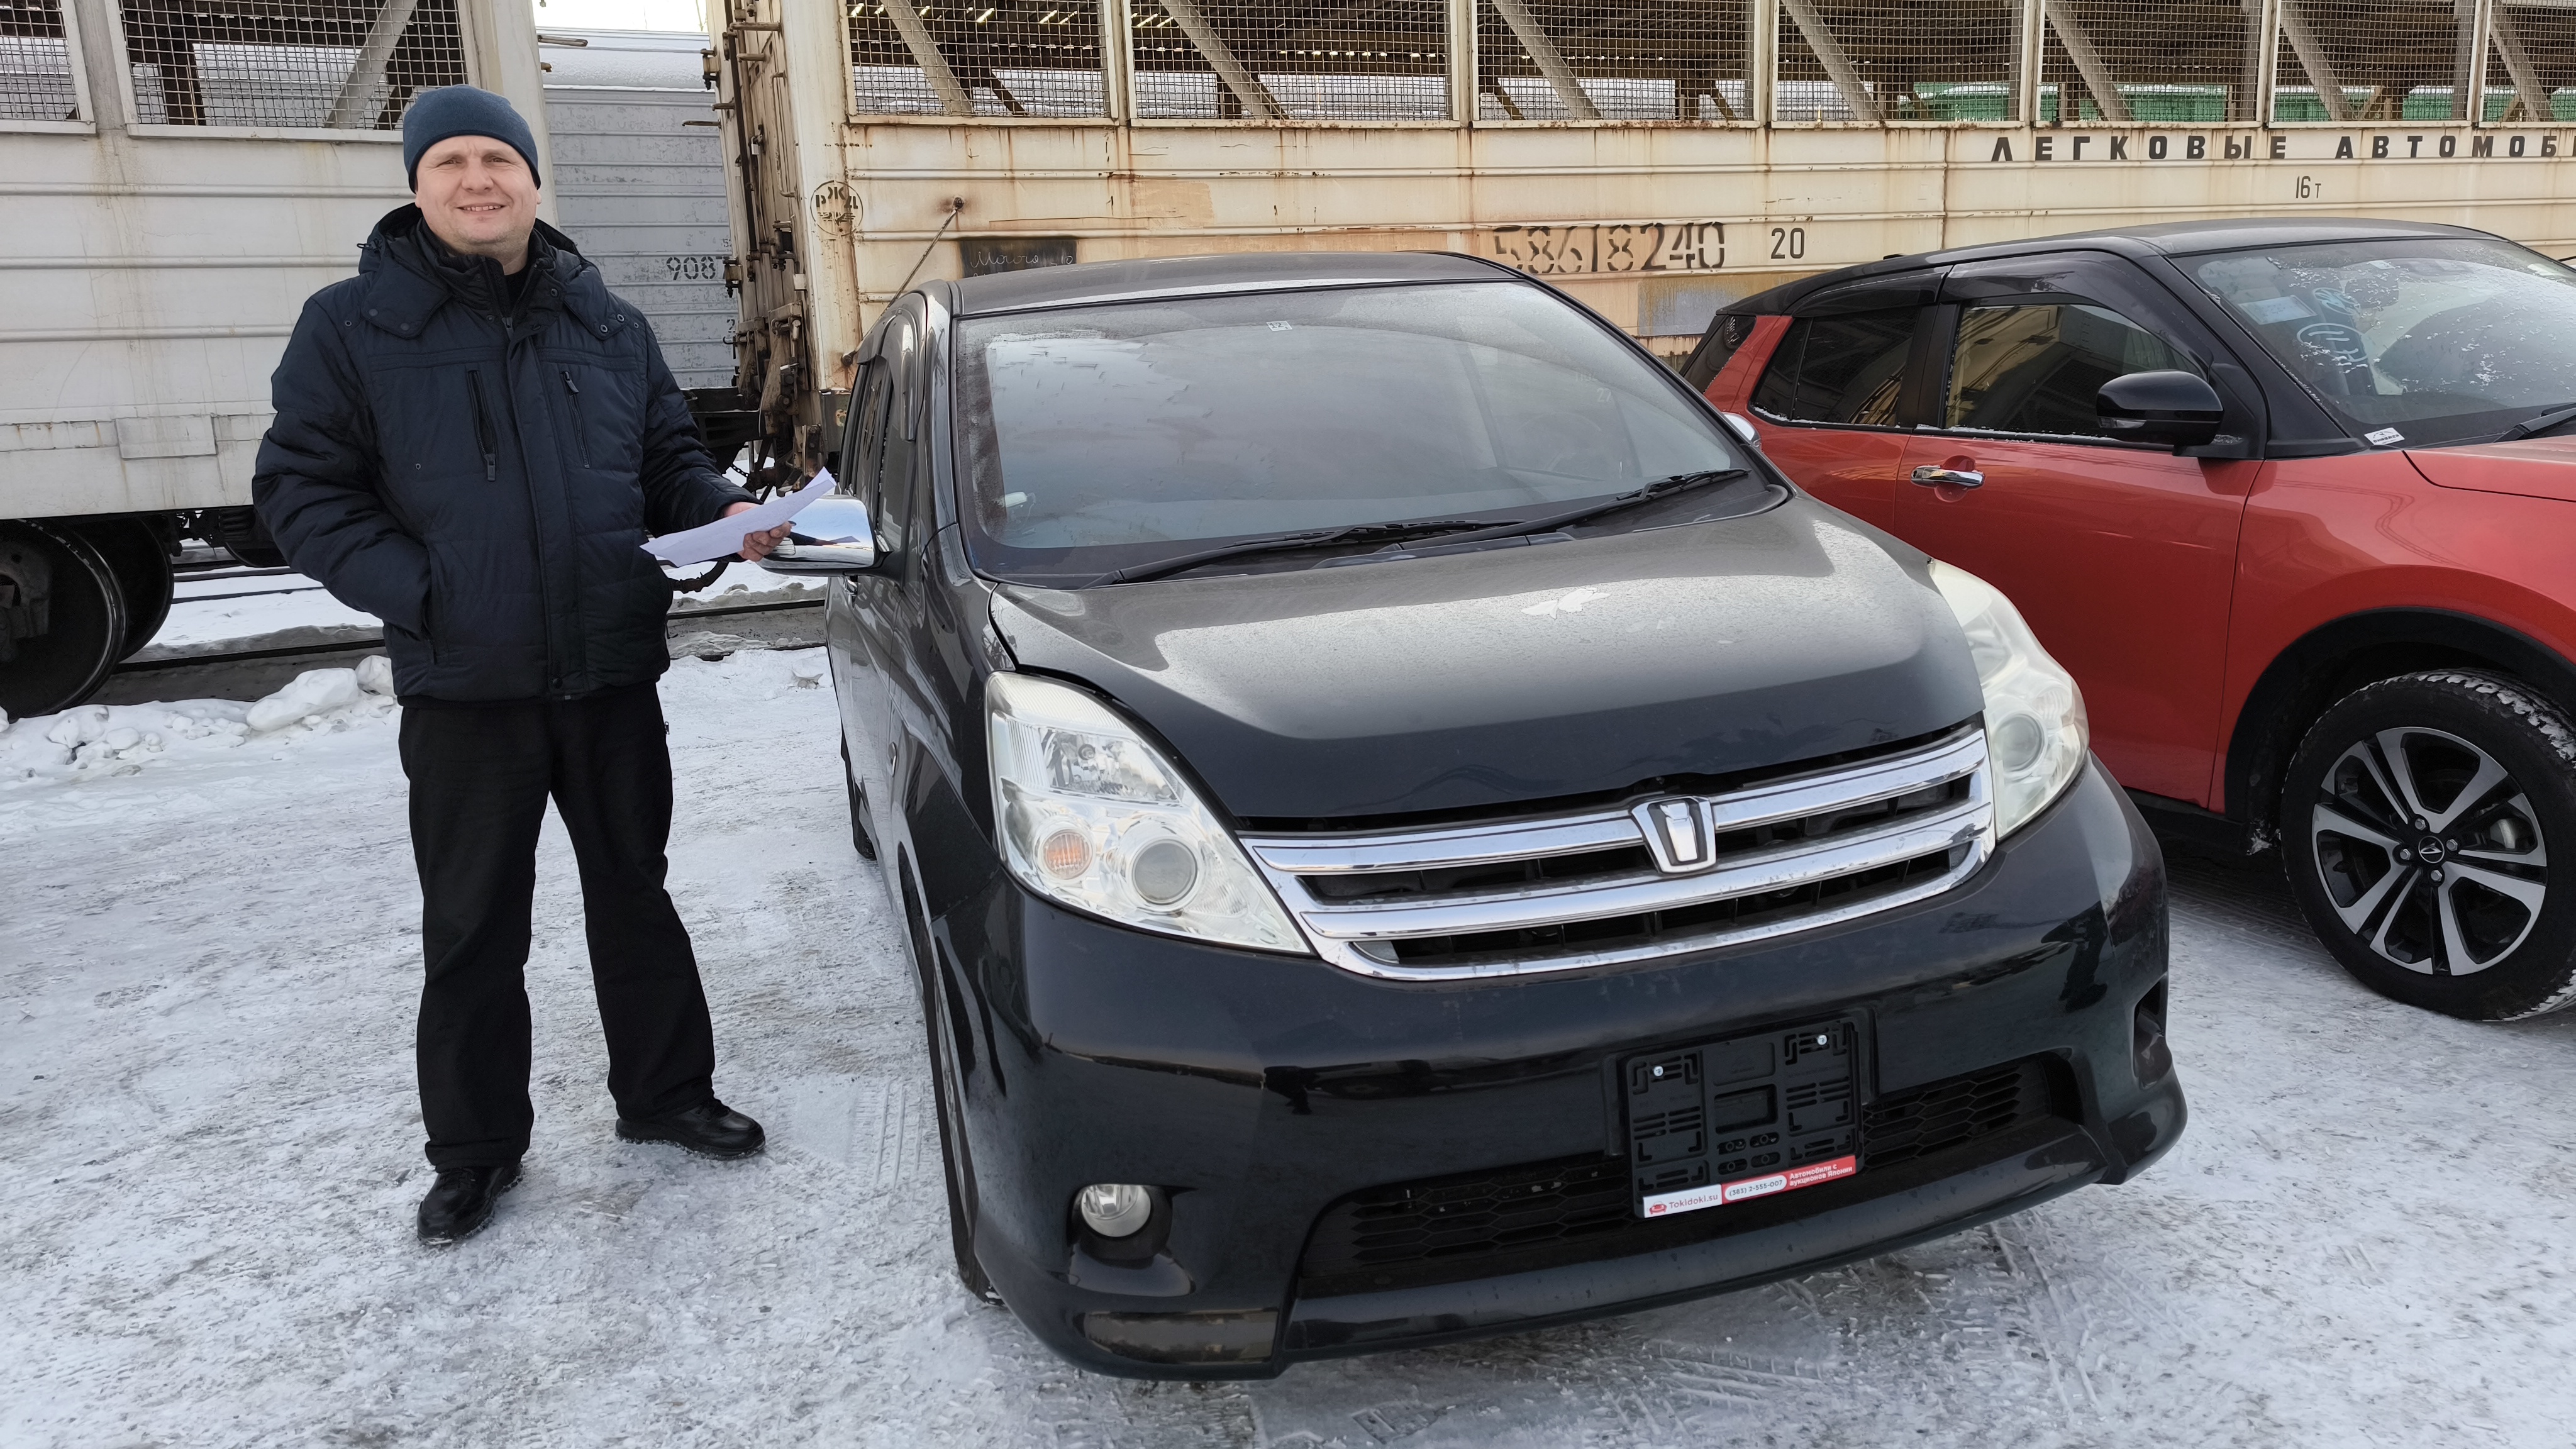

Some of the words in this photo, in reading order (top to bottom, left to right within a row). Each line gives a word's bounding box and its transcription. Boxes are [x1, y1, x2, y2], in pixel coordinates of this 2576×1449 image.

[1991, 135, 2287, 162] ЛЕГКОВЫЕ
[1494, 222, 1725, 274] 58618240
[1771, 228, 1805, 259] 20
[1790, 1165, 1831, 1180] Автомобили
[1790, 1173, 1826, 1187] аукционов
[1827, 1166, 1853, 1178] Японии
[1729, 1187, 1747, 1197] (383)
[1749, 1179, 1783, 1192] 2-555-007
[1669, 1194, 1718, 1209] Tokidoki.su
